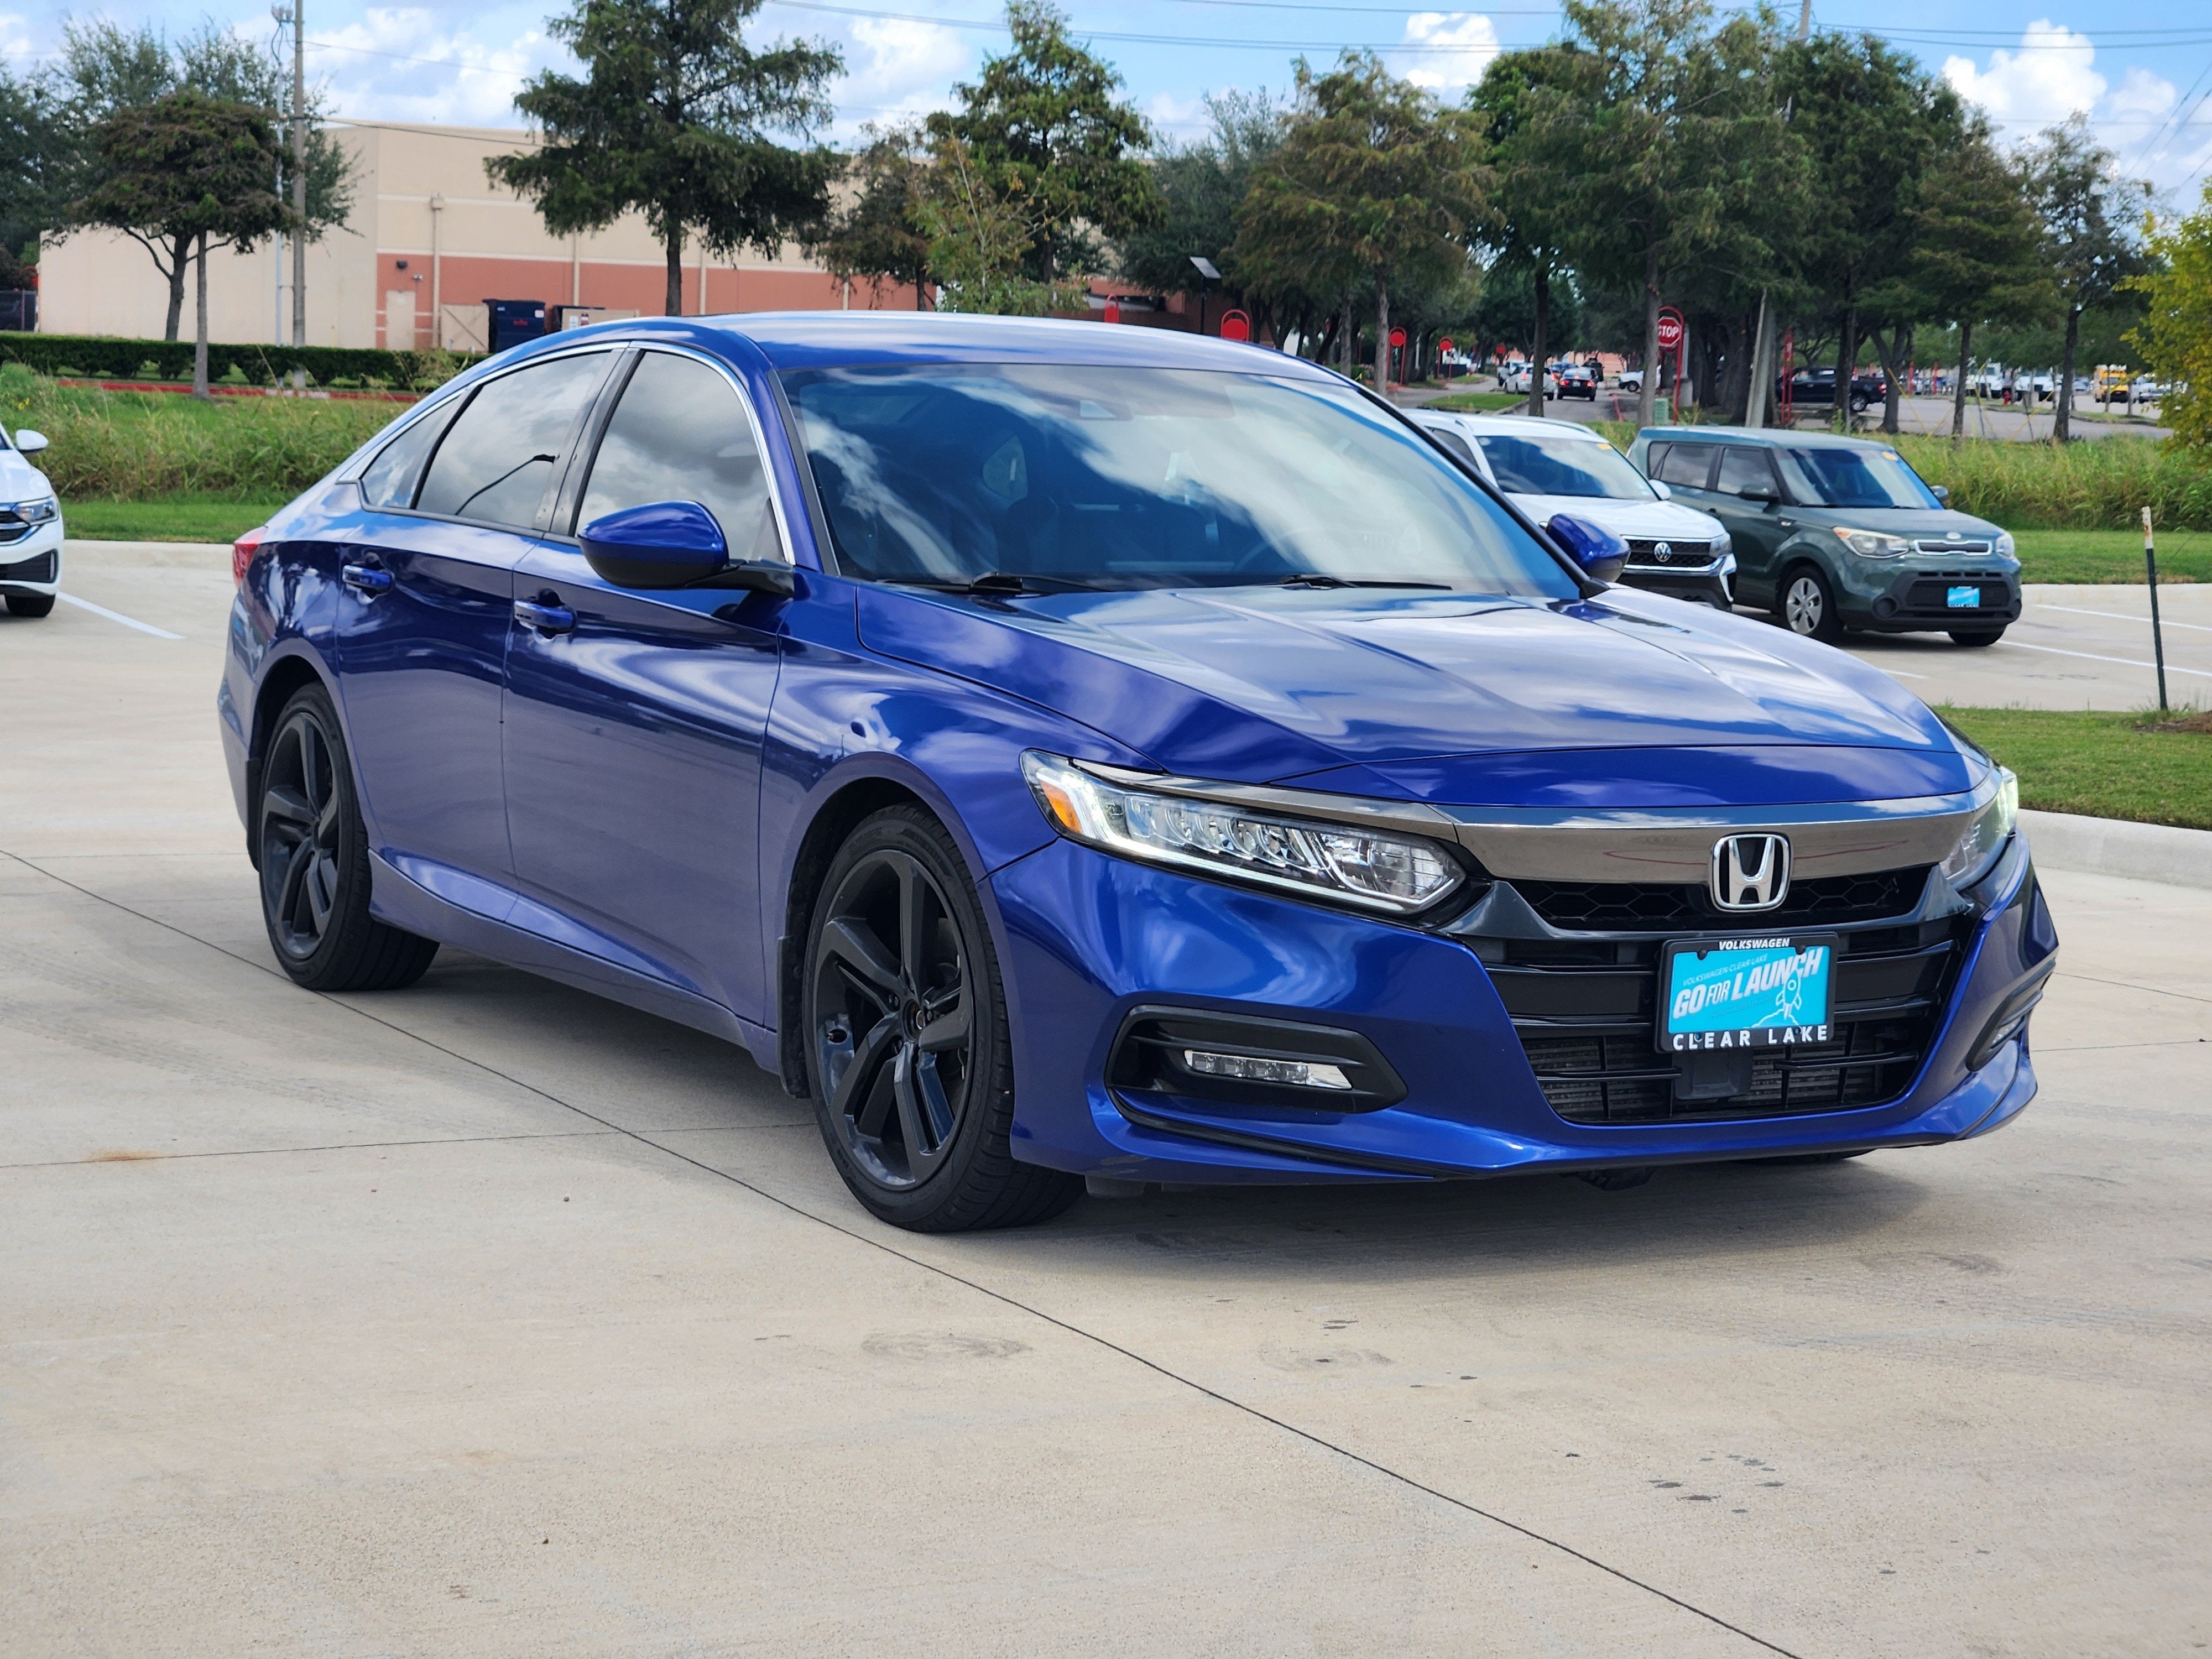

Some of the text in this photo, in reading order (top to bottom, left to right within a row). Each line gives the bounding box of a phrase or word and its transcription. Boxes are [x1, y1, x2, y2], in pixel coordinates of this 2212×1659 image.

[1719, 938, 1790, 951] VOLKSWAGEN
[1673, 984, 1707, 1019] GO
[1705, 979, 1731, 1007] FOR
[1730, 947, 1823, 1001] LAUNCH
[1683, 953, 1768, 986] VOLKSWAGEN CLEAR LAKE
[1673, 1025, 1827, 1051] CLEAR LAKE
